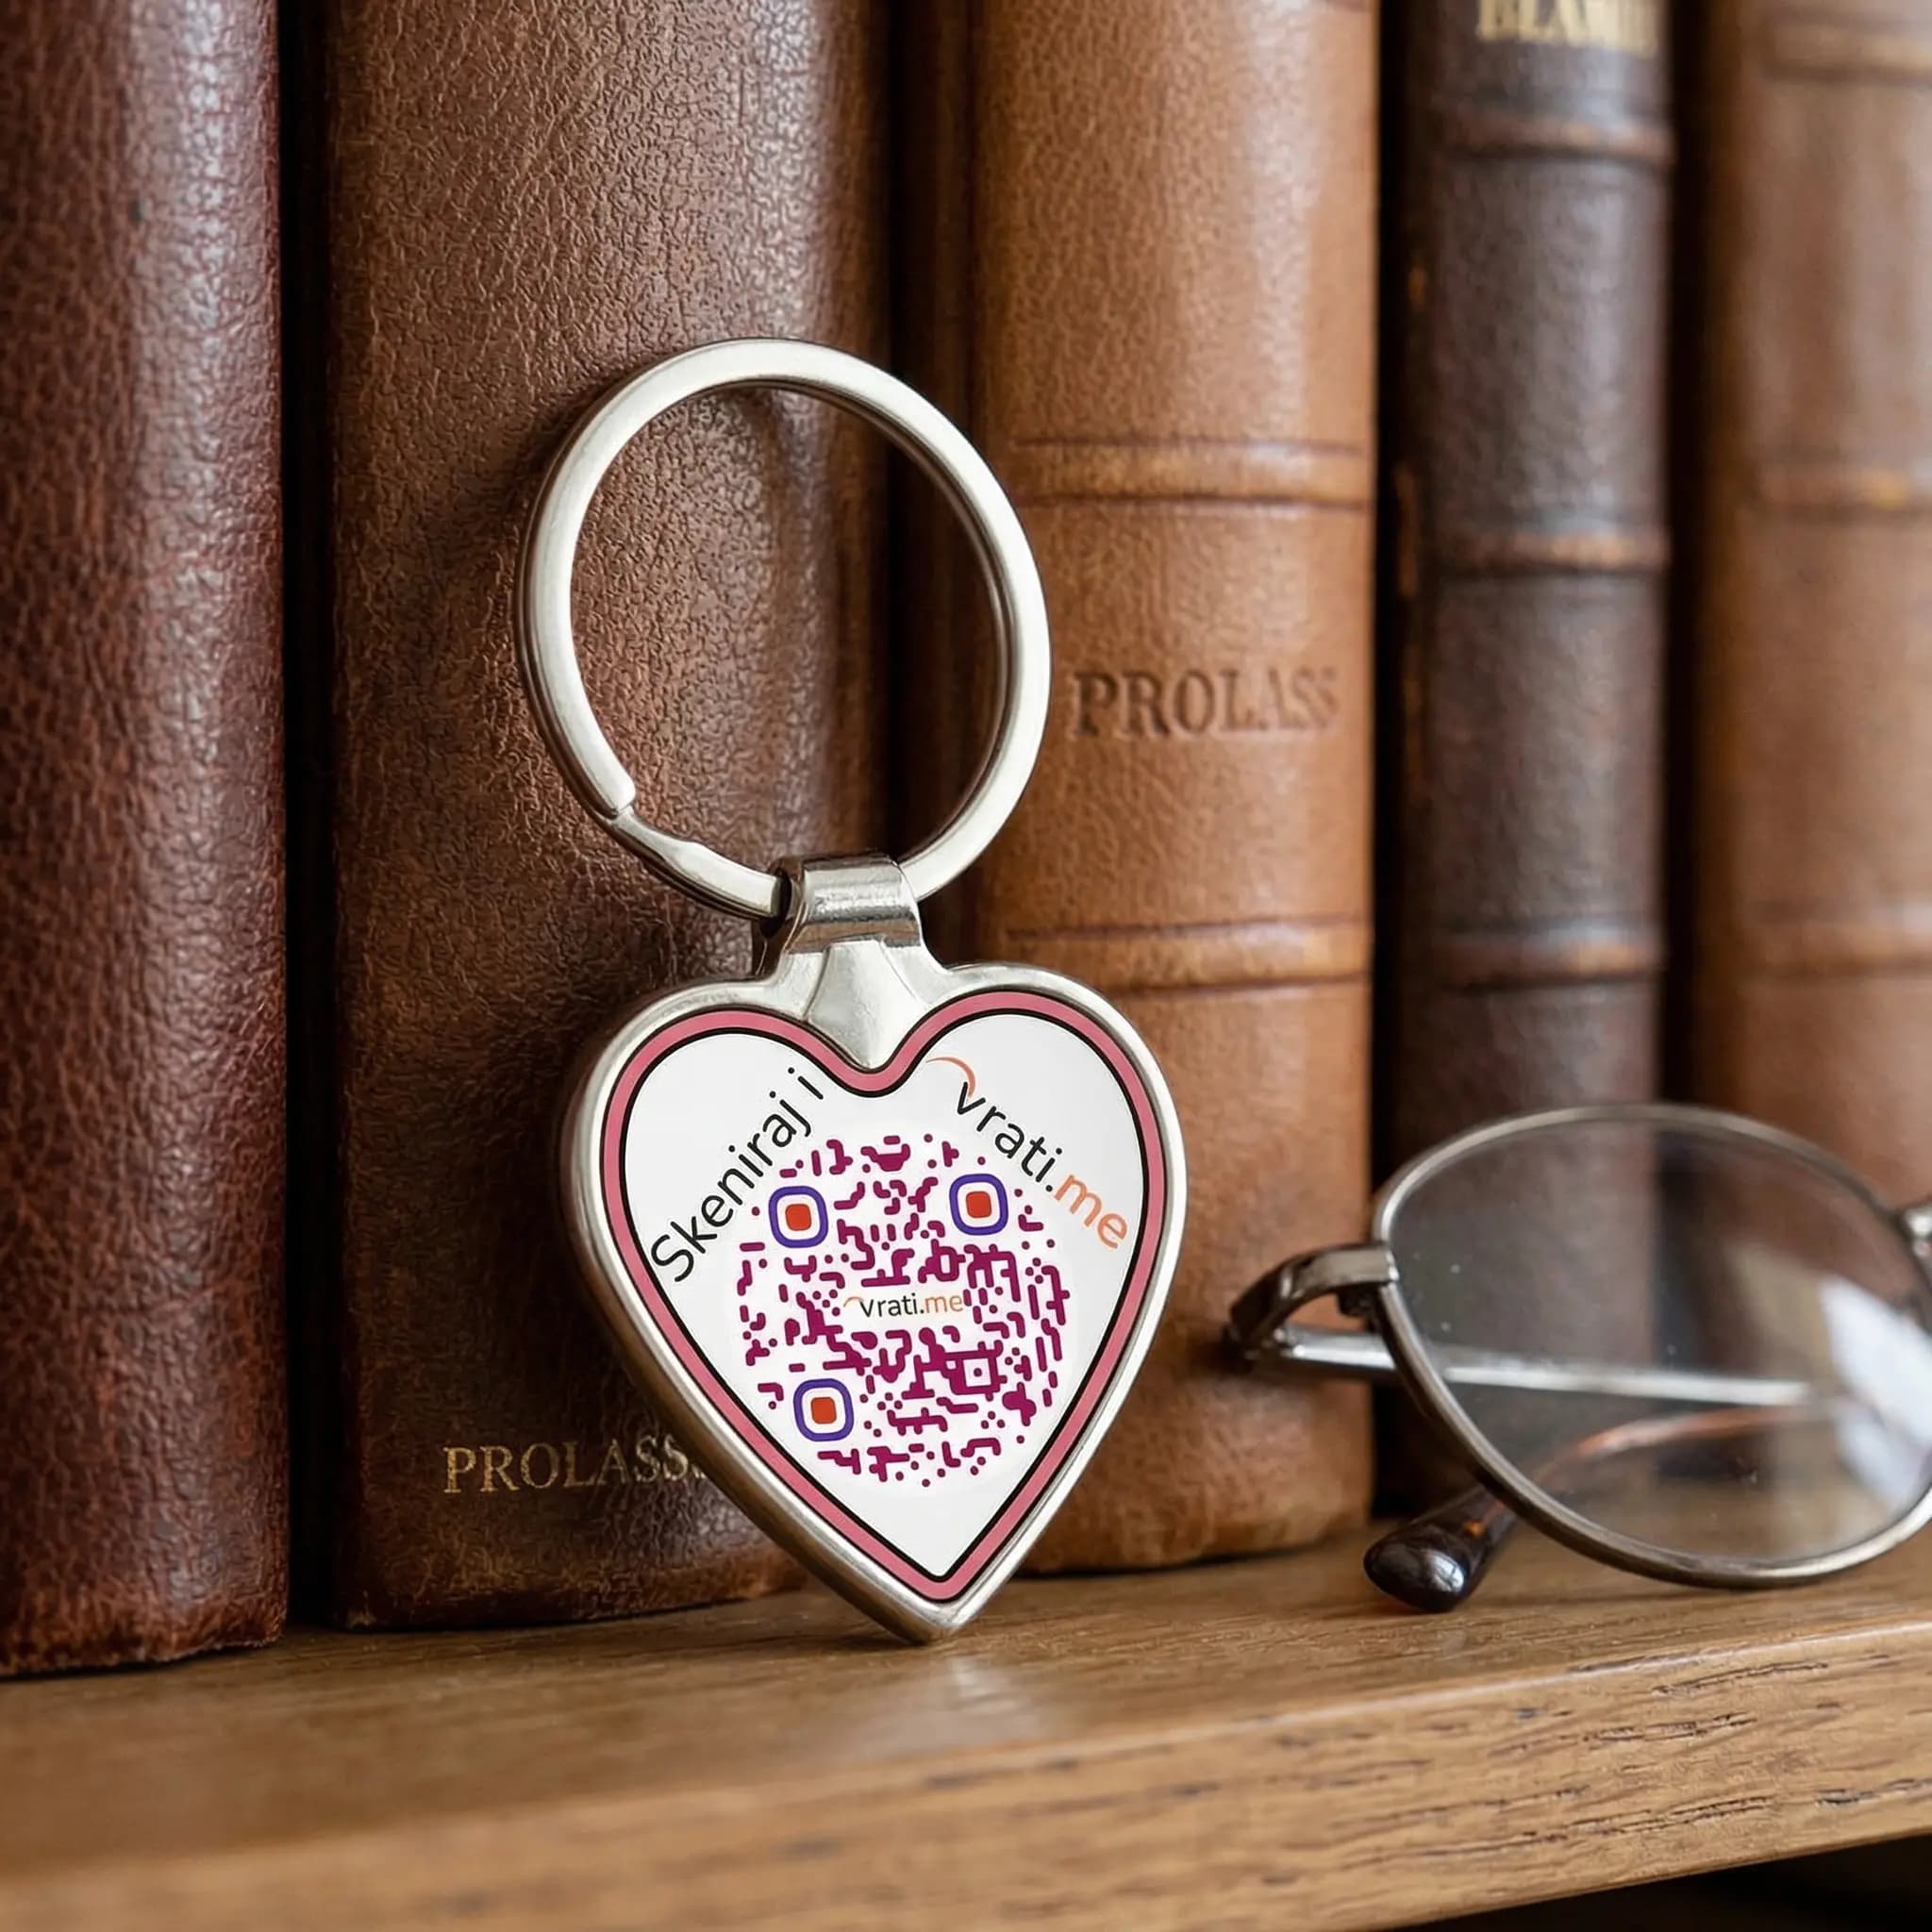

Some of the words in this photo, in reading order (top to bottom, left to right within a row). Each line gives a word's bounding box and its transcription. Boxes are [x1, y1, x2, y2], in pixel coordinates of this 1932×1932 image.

[651, 1091, 811, 1282] Skeniraj
[788, 1067, 824, 1100] i
[957, 1081, 1128, 1250] vrati.me
[859, 1292, 963, 1318] vrati.me
[442, 1434, 707, 1493] PROLASS
